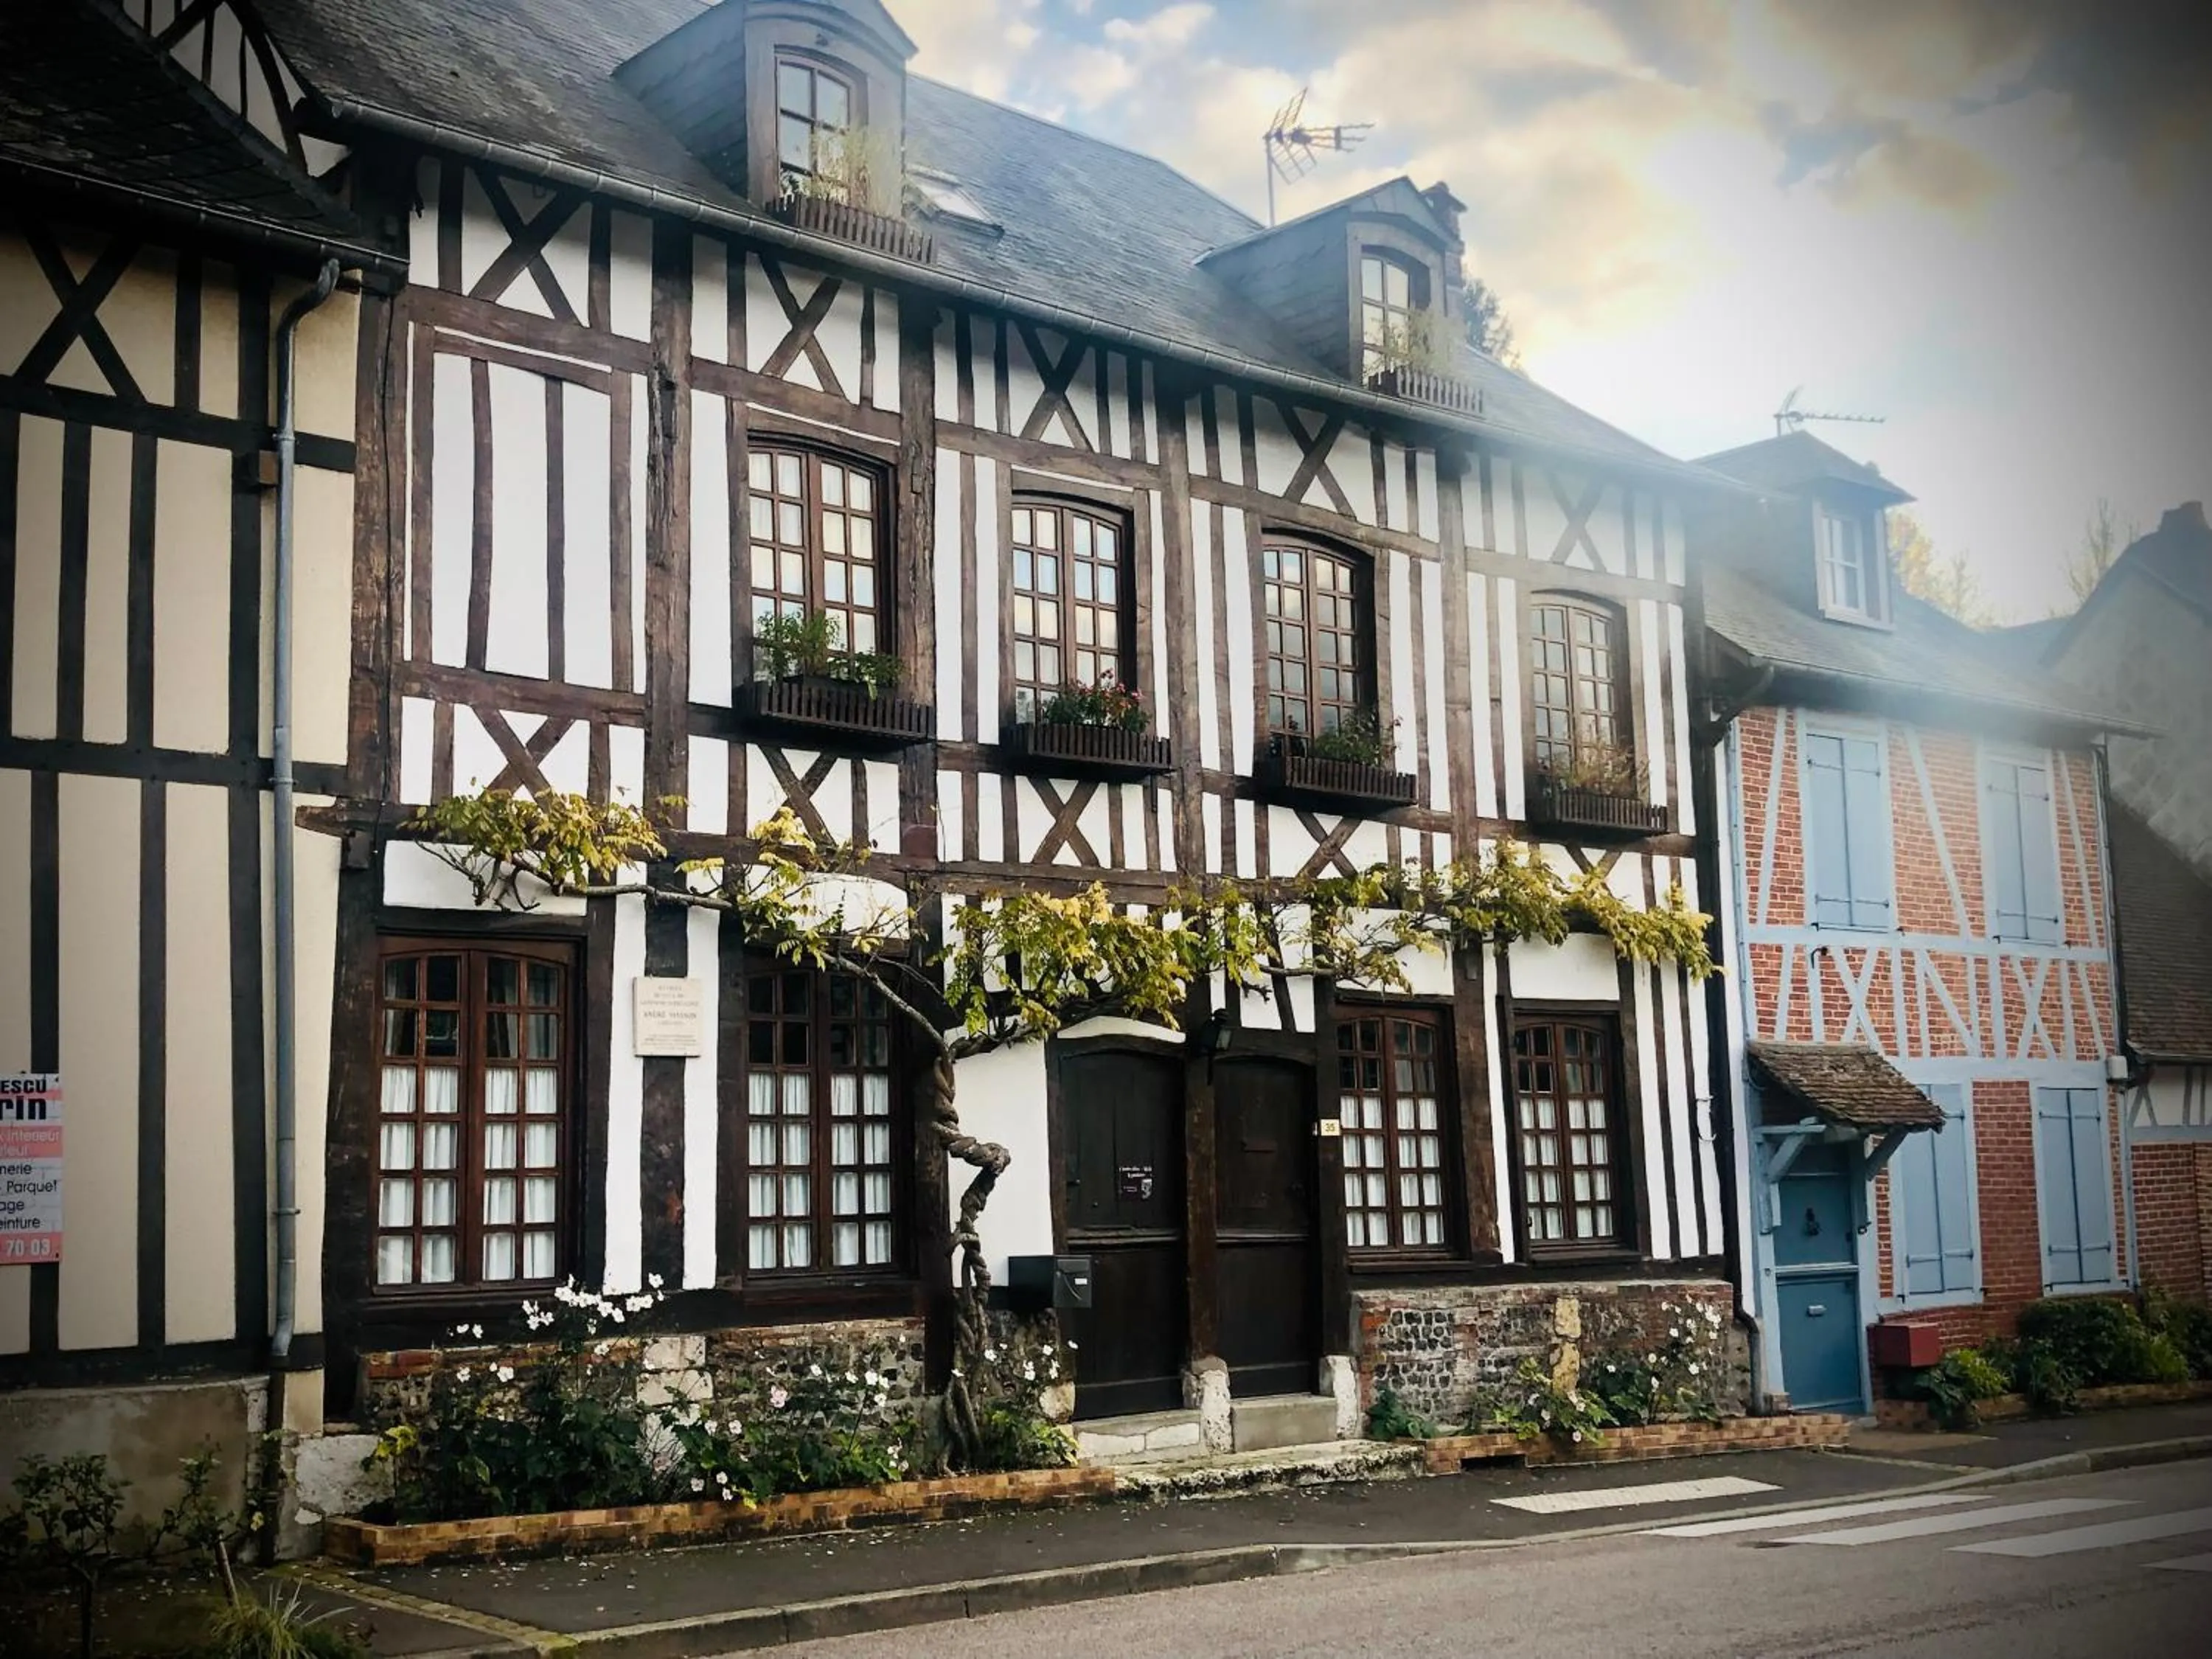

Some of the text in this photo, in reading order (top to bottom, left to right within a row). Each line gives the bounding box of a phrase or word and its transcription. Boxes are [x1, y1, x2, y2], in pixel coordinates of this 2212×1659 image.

[1, 1079, 46, 1093] ESCU
[7, 1180, 57, 1195] Parquet
[6, 1239, 24, 1257] 70
